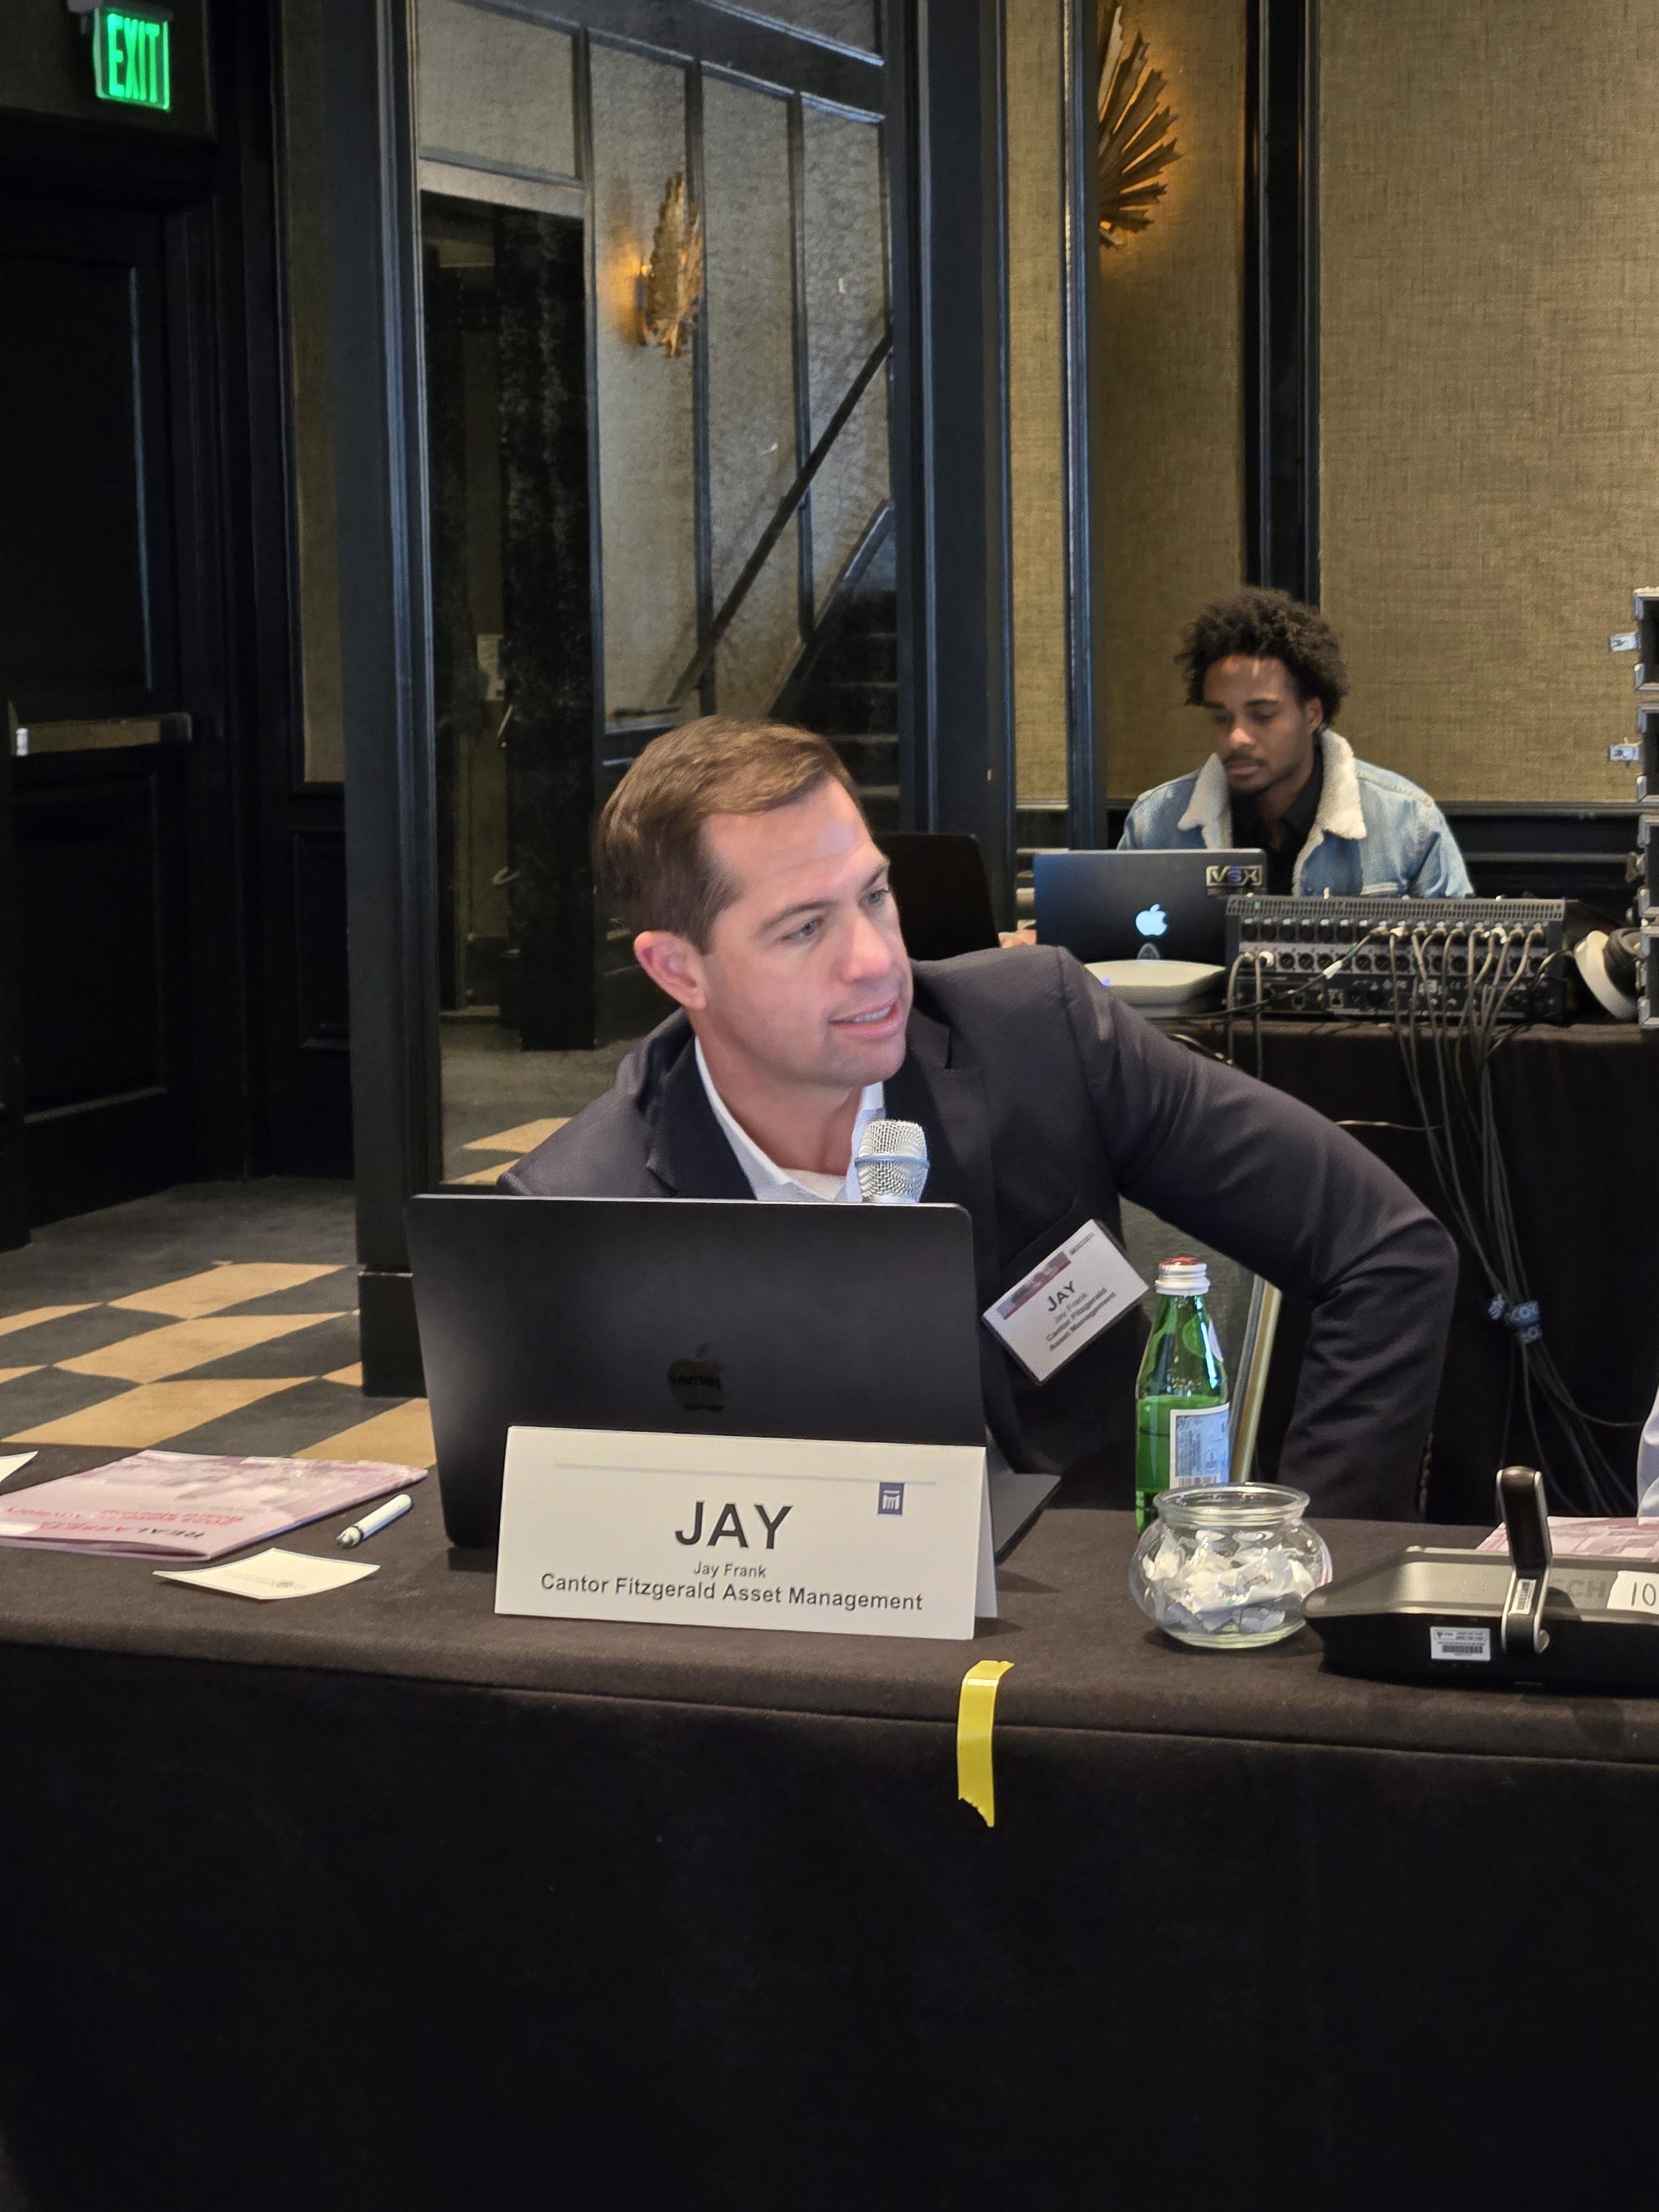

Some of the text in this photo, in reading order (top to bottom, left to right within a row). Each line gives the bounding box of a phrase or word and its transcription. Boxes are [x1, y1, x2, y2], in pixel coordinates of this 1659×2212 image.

[107, 13, 160, 103] EXIT
[1047, 1280, 1075, 1312] JAY
[675, 1501, 793, 1550] JAY
[693, 1561, 767, 1578] Jay Frank
[541, 1573, 924, 1611] Cantor Fitzgerald Asset Management
[1631, 1581, 1656, 1606] 10
